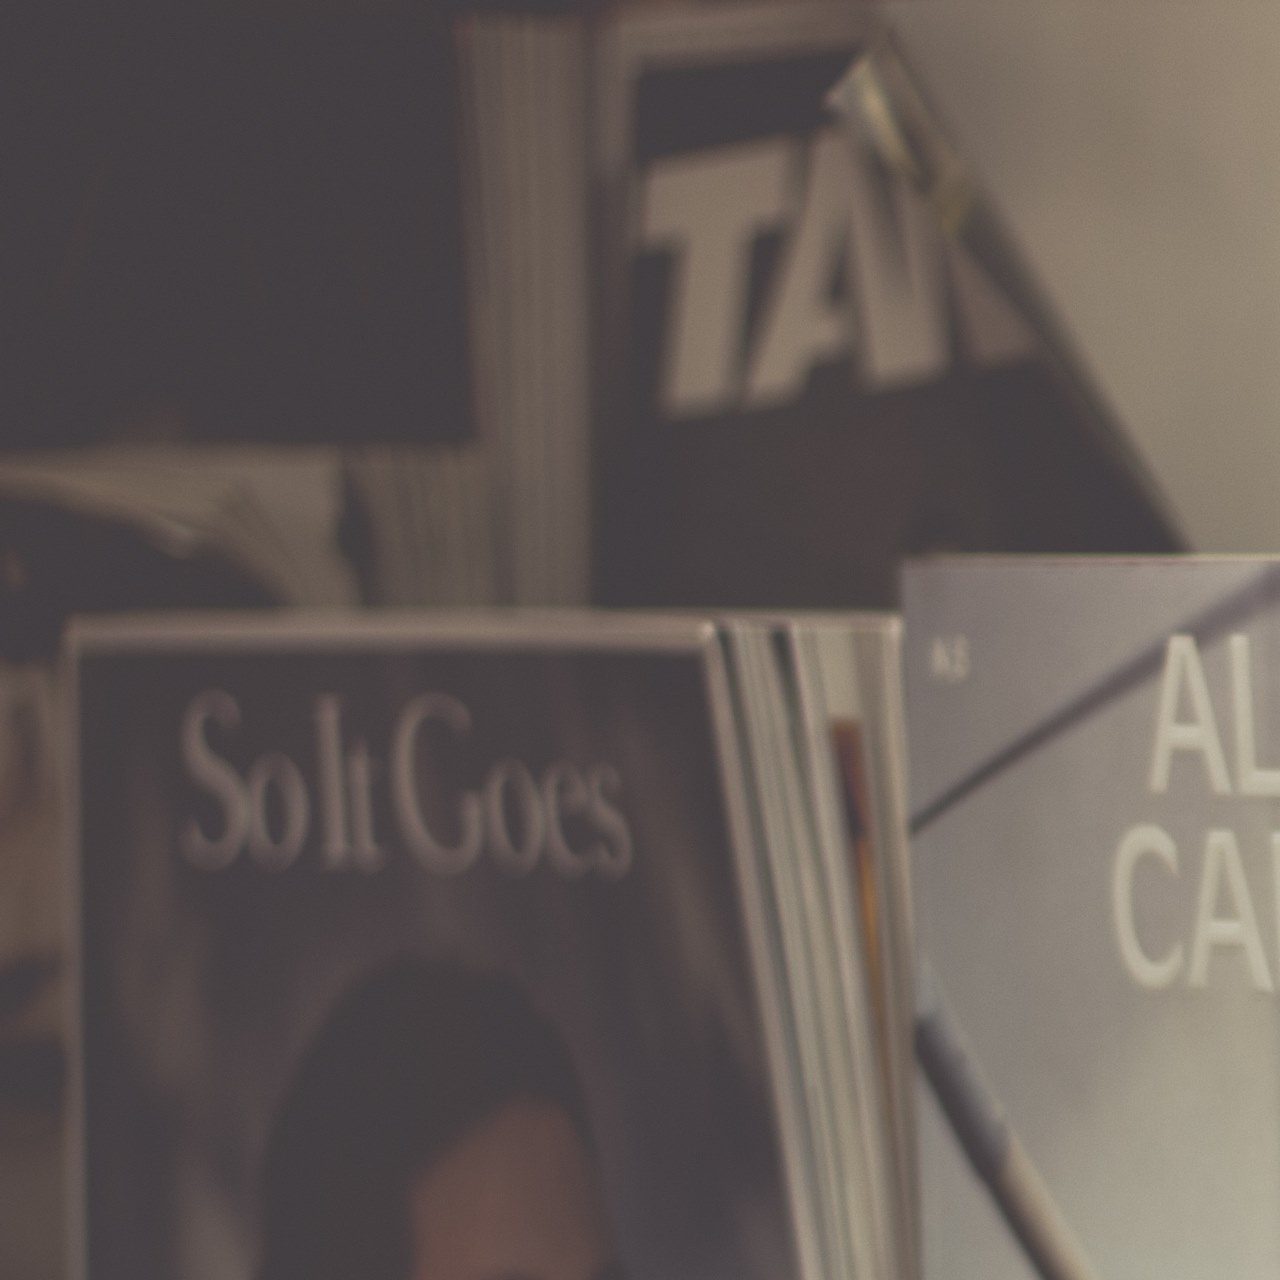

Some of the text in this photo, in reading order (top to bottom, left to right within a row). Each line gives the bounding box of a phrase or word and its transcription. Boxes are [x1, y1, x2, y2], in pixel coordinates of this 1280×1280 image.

[178, 688, 635, 880] So It Goes
